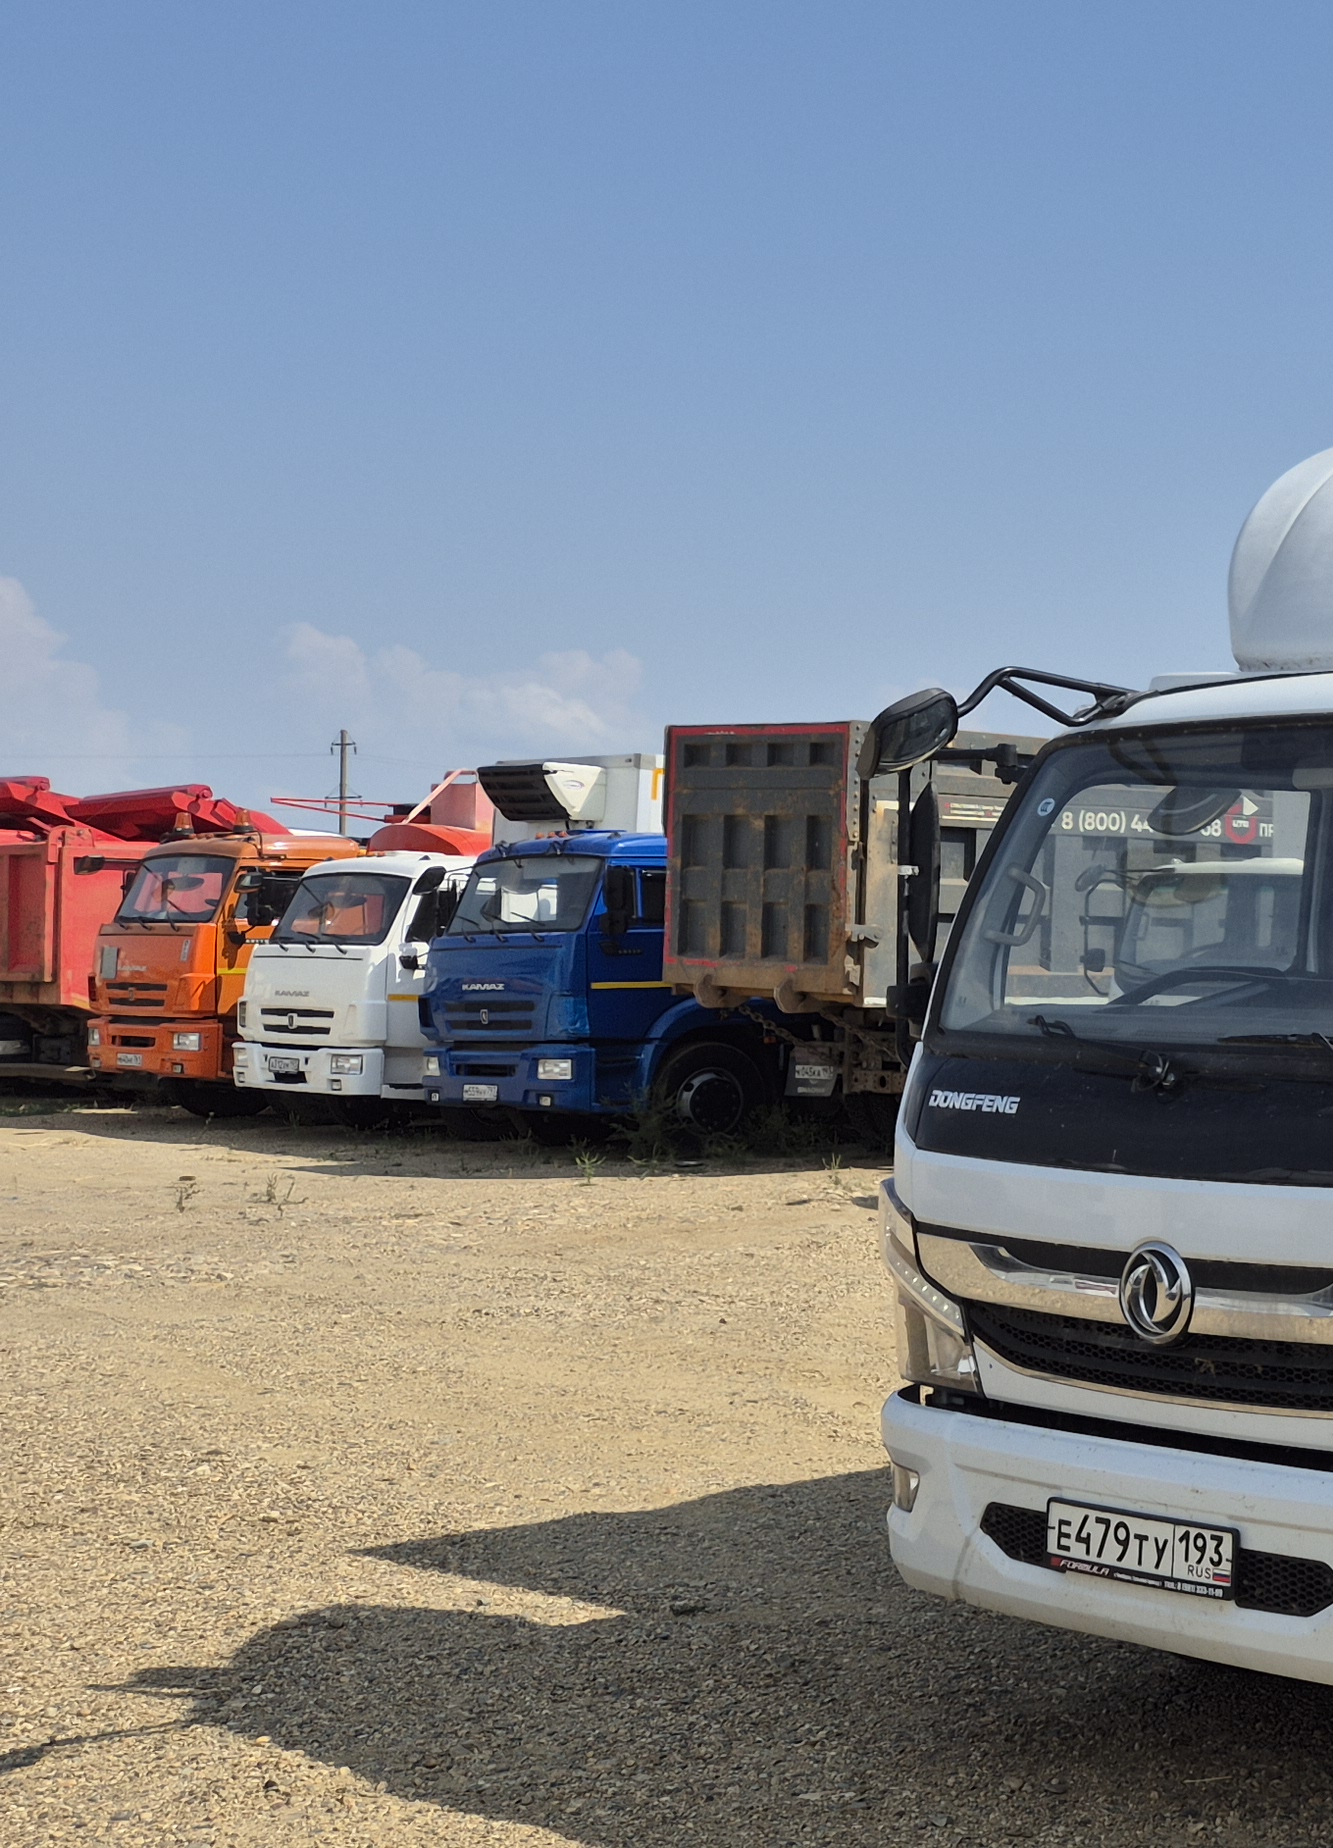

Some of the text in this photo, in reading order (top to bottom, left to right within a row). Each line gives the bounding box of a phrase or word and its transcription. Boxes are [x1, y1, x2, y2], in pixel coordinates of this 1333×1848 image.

[1061, 812, 1073, 830] 8
[1079, 810, 1126, 833] (800)
[462, 983, 505, 991] KAMAZ
[928, 1089, 1021, 1114] DONGFENG
[1057, 1514, 1224, 1569] Е479ТУ 193
[1059, 1559, 1110, 1576] FORMULA
[1187, 1564, 1212, 1580] RUS
